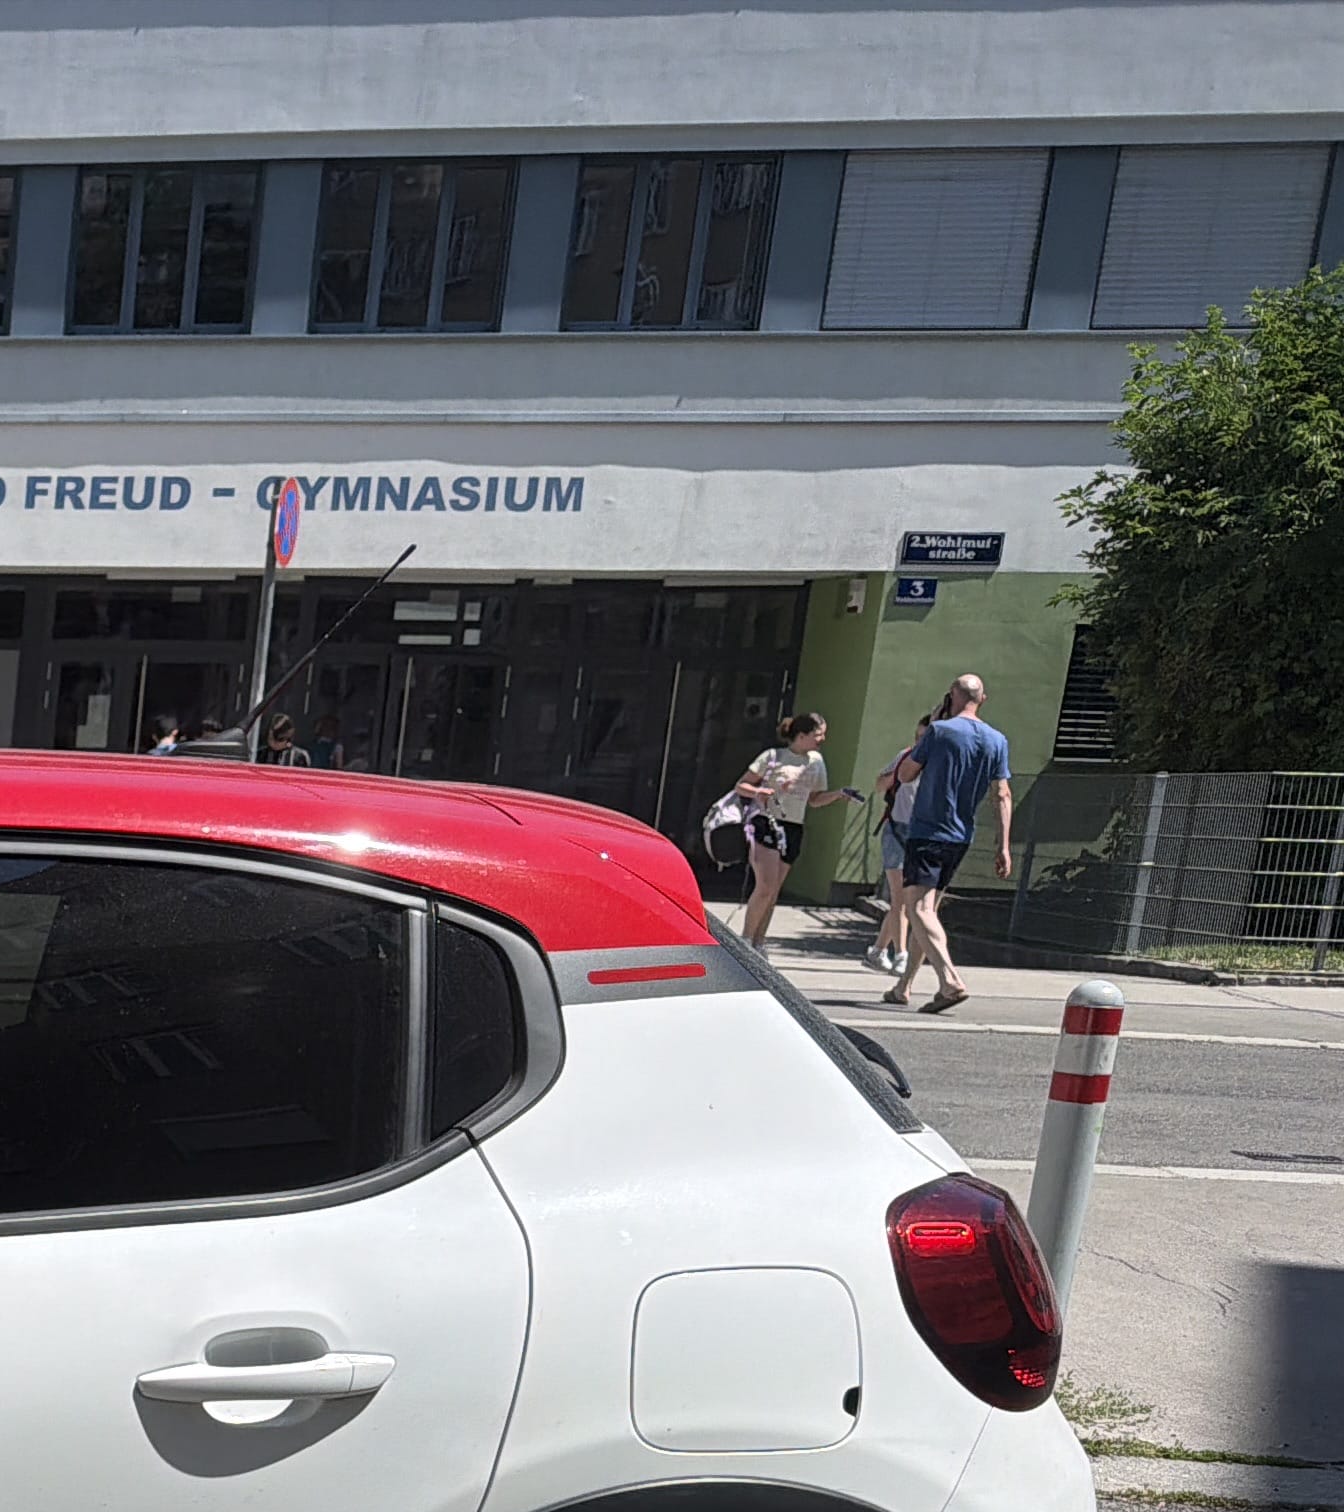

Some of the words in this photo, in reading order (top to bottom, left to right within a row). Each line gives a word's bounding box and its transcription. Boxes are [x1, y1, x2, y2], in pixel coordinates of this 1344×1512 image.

[24, 475, 192, 510] FREUD
[928, 549, 976, 560] straße
[910, 581, 924, 596] 3
